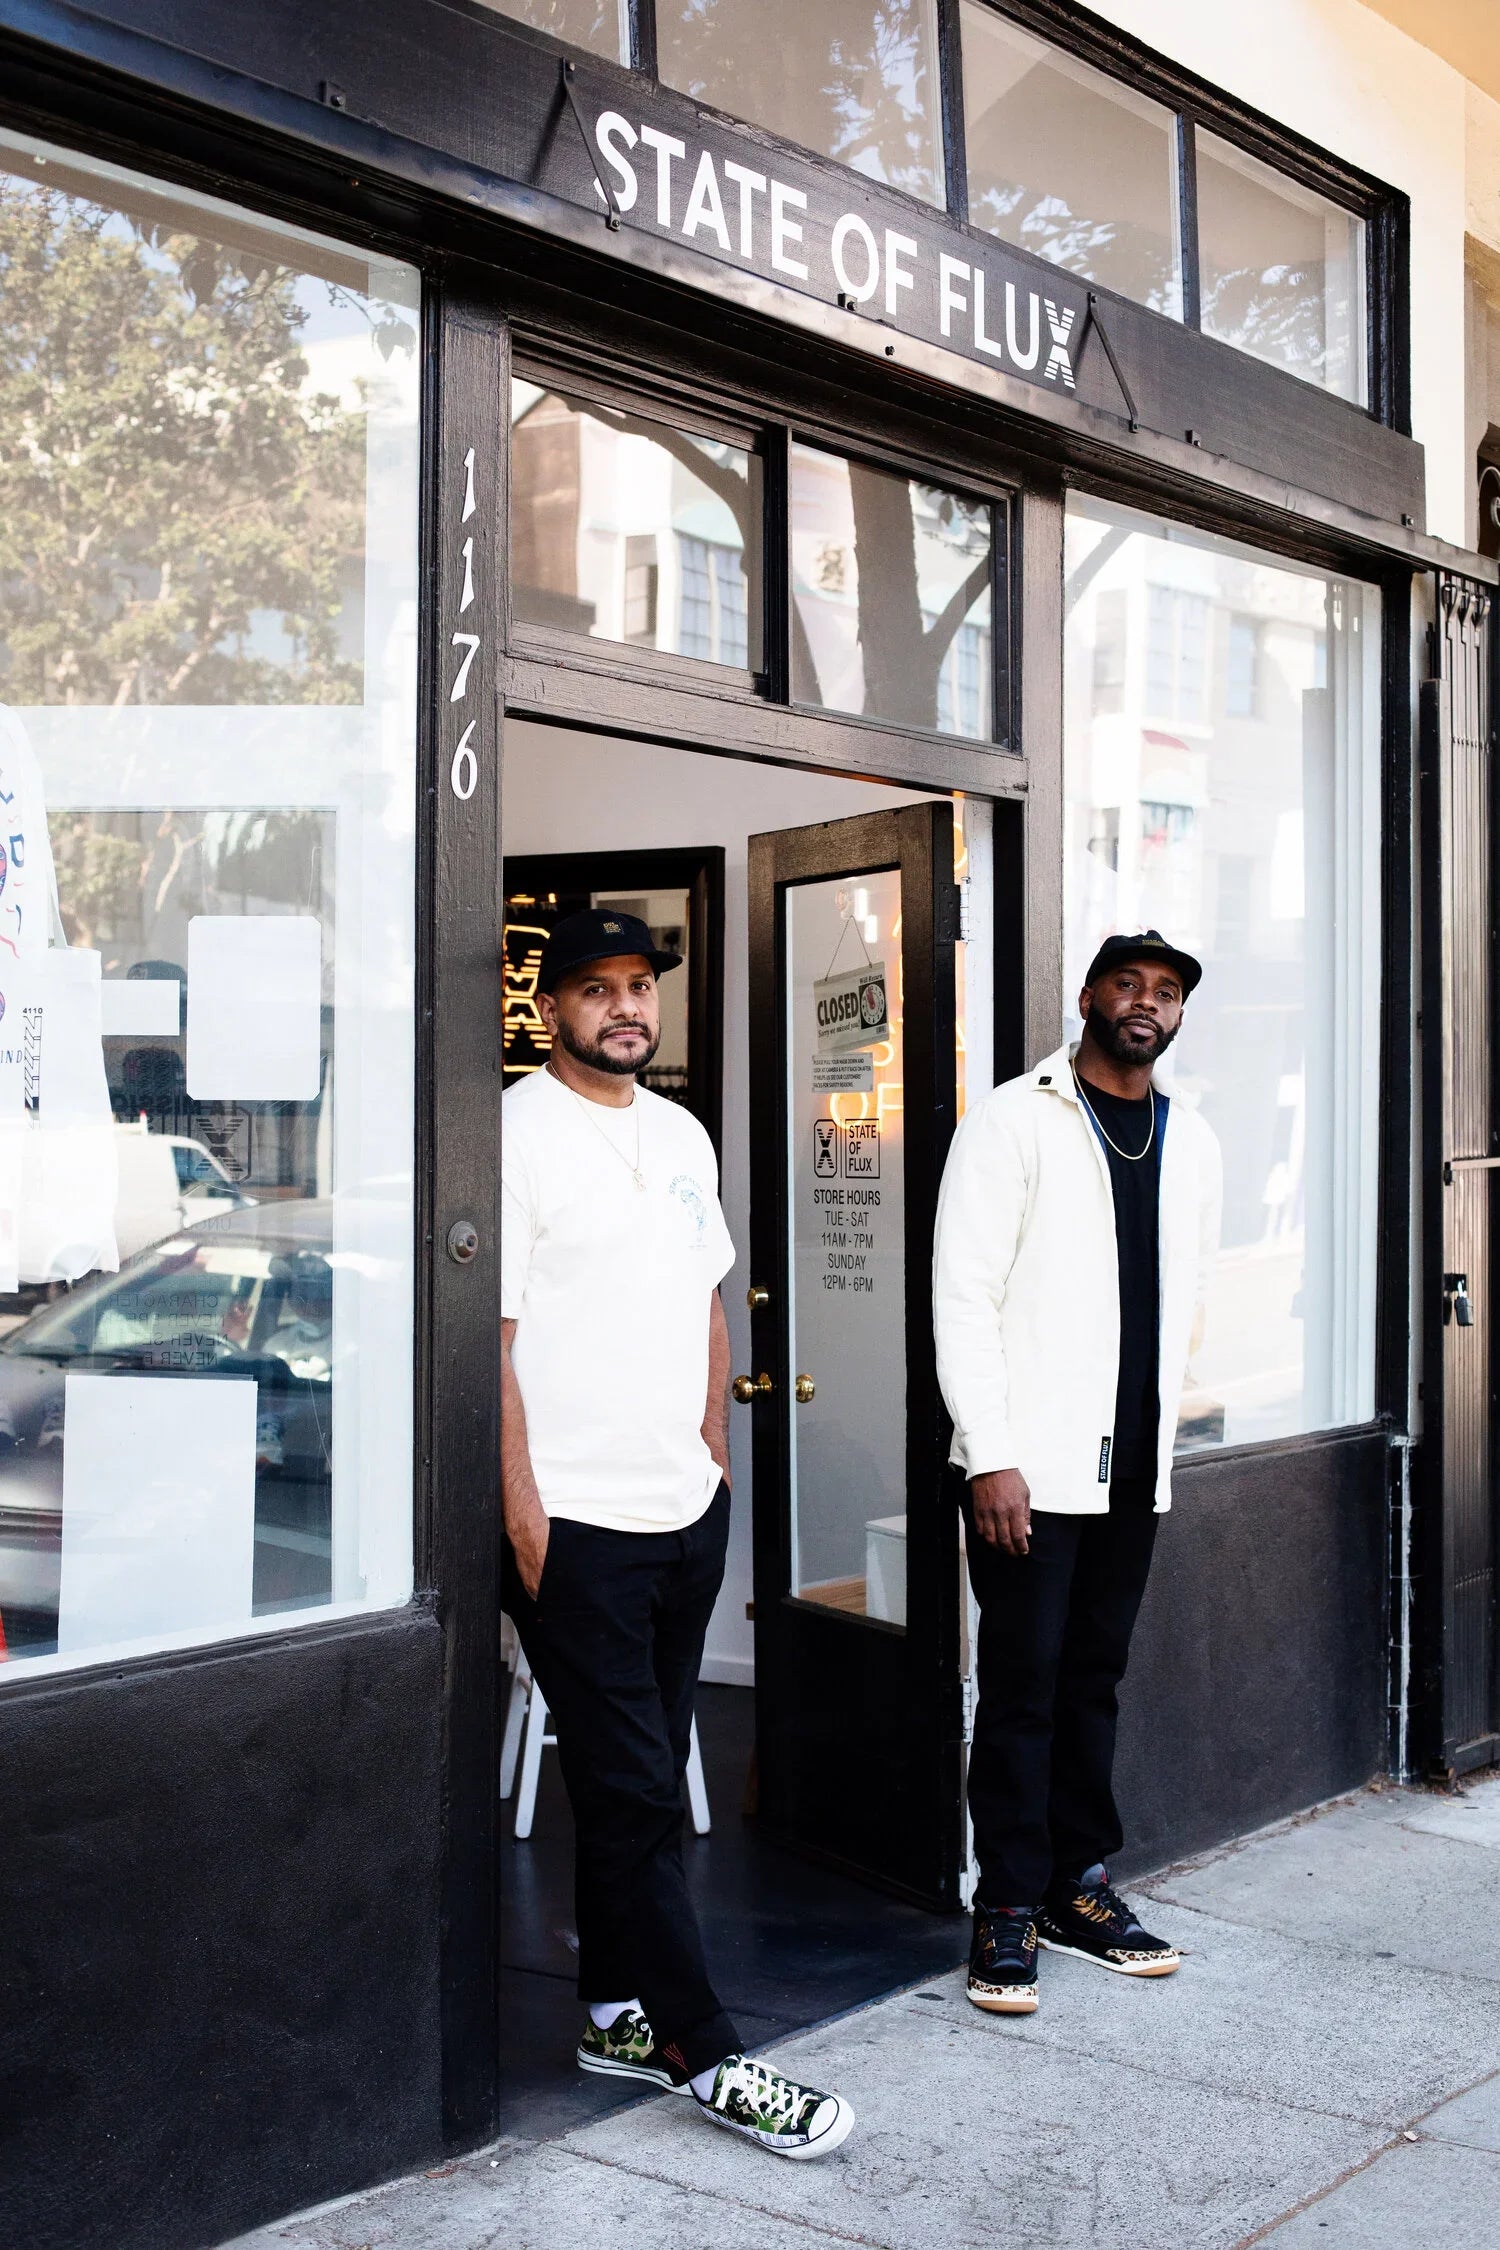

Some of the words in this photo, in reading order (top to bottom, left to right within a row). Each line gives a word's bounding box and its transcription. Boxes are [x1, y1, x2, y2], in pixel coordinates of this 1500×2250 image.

[594, 110, 809, 281] STATE
[831, 212, 918, 316] OF
[939, 251, 1076, 389] FLUX
[450, 447, 481, 801] 1176
[22, 1007, 43, 1015] 4110
[817, 992, 859, 1027] CLOSED
[849, 1124, 877, 1139] STATE
[848, 1141, 862, 1155] OF
[848, 1157, 872, 1172] FLUX
[814, 1188, 845, 1205] STORE
[847, 1190, 881, 1206] HOURS
[825, 1210, 844, 1226] TUE
[851, 1211, 869, 1227] SAT
[821, 1232, 846, 1248] 11AM
[854, 1233, 874, 1249] 7PM
[828, 1253, 867, 1270] SUNDAY
[822, 1274, 846, 1290] 12PM
[853, 1276, 873, 1293] 6PM
[1102, 1440, 1110, 1455] FLUX
[1101, 1454, 1107, 1463] OF
